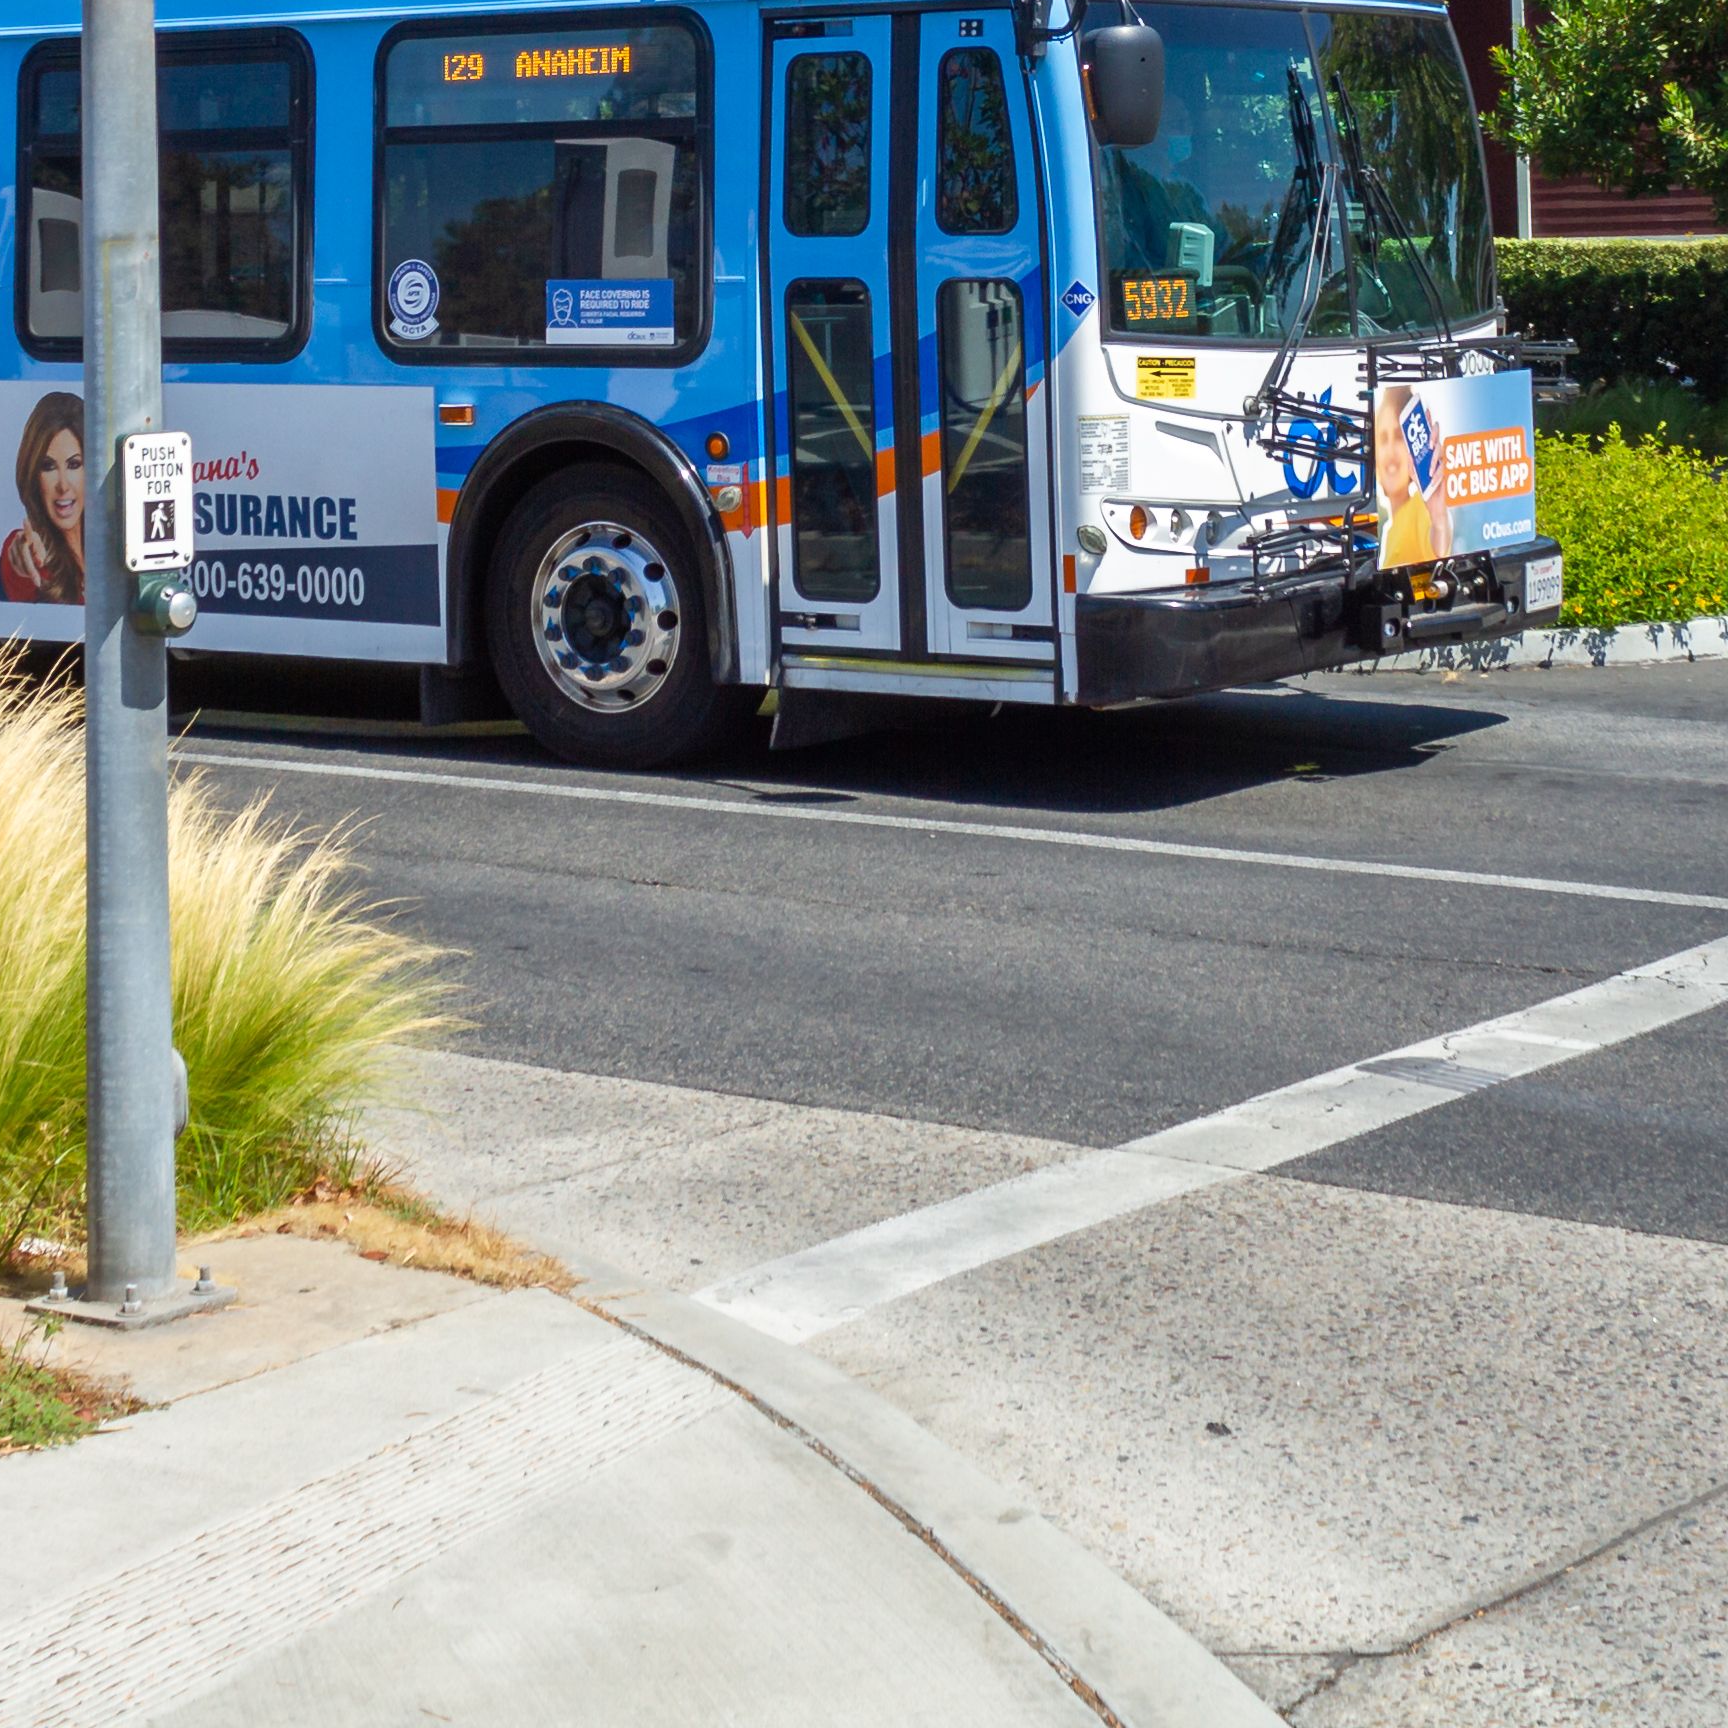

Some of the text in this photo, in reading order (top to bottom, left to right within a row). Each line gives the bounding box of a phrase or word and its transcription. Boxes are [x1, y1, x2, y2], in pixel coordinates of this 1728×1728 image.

[444, 46, 630, 81] 129 ANAHEIM
[580, 290, 650, 300] FACE COVERING IS
[1065, 293, 1092, 305] CNG
[1124, 279, 1189, 321] 5932
[580, 300, 650, 309] REQUIRED TO RIDE
[401, 324, 427, 334] OCTA
[141, 446, 176, 462] PUSH
[1445, 439, 1482, 470] SAVE
[1483, 435, 1521, 464] WITH
[134, 462, 183, 480] BUTTON
[147, 480, 171, 495] FOR
[1446, 462, 1529, 499] OC BUS APP
[1482, 519, 1532, 541] OCbus.com
